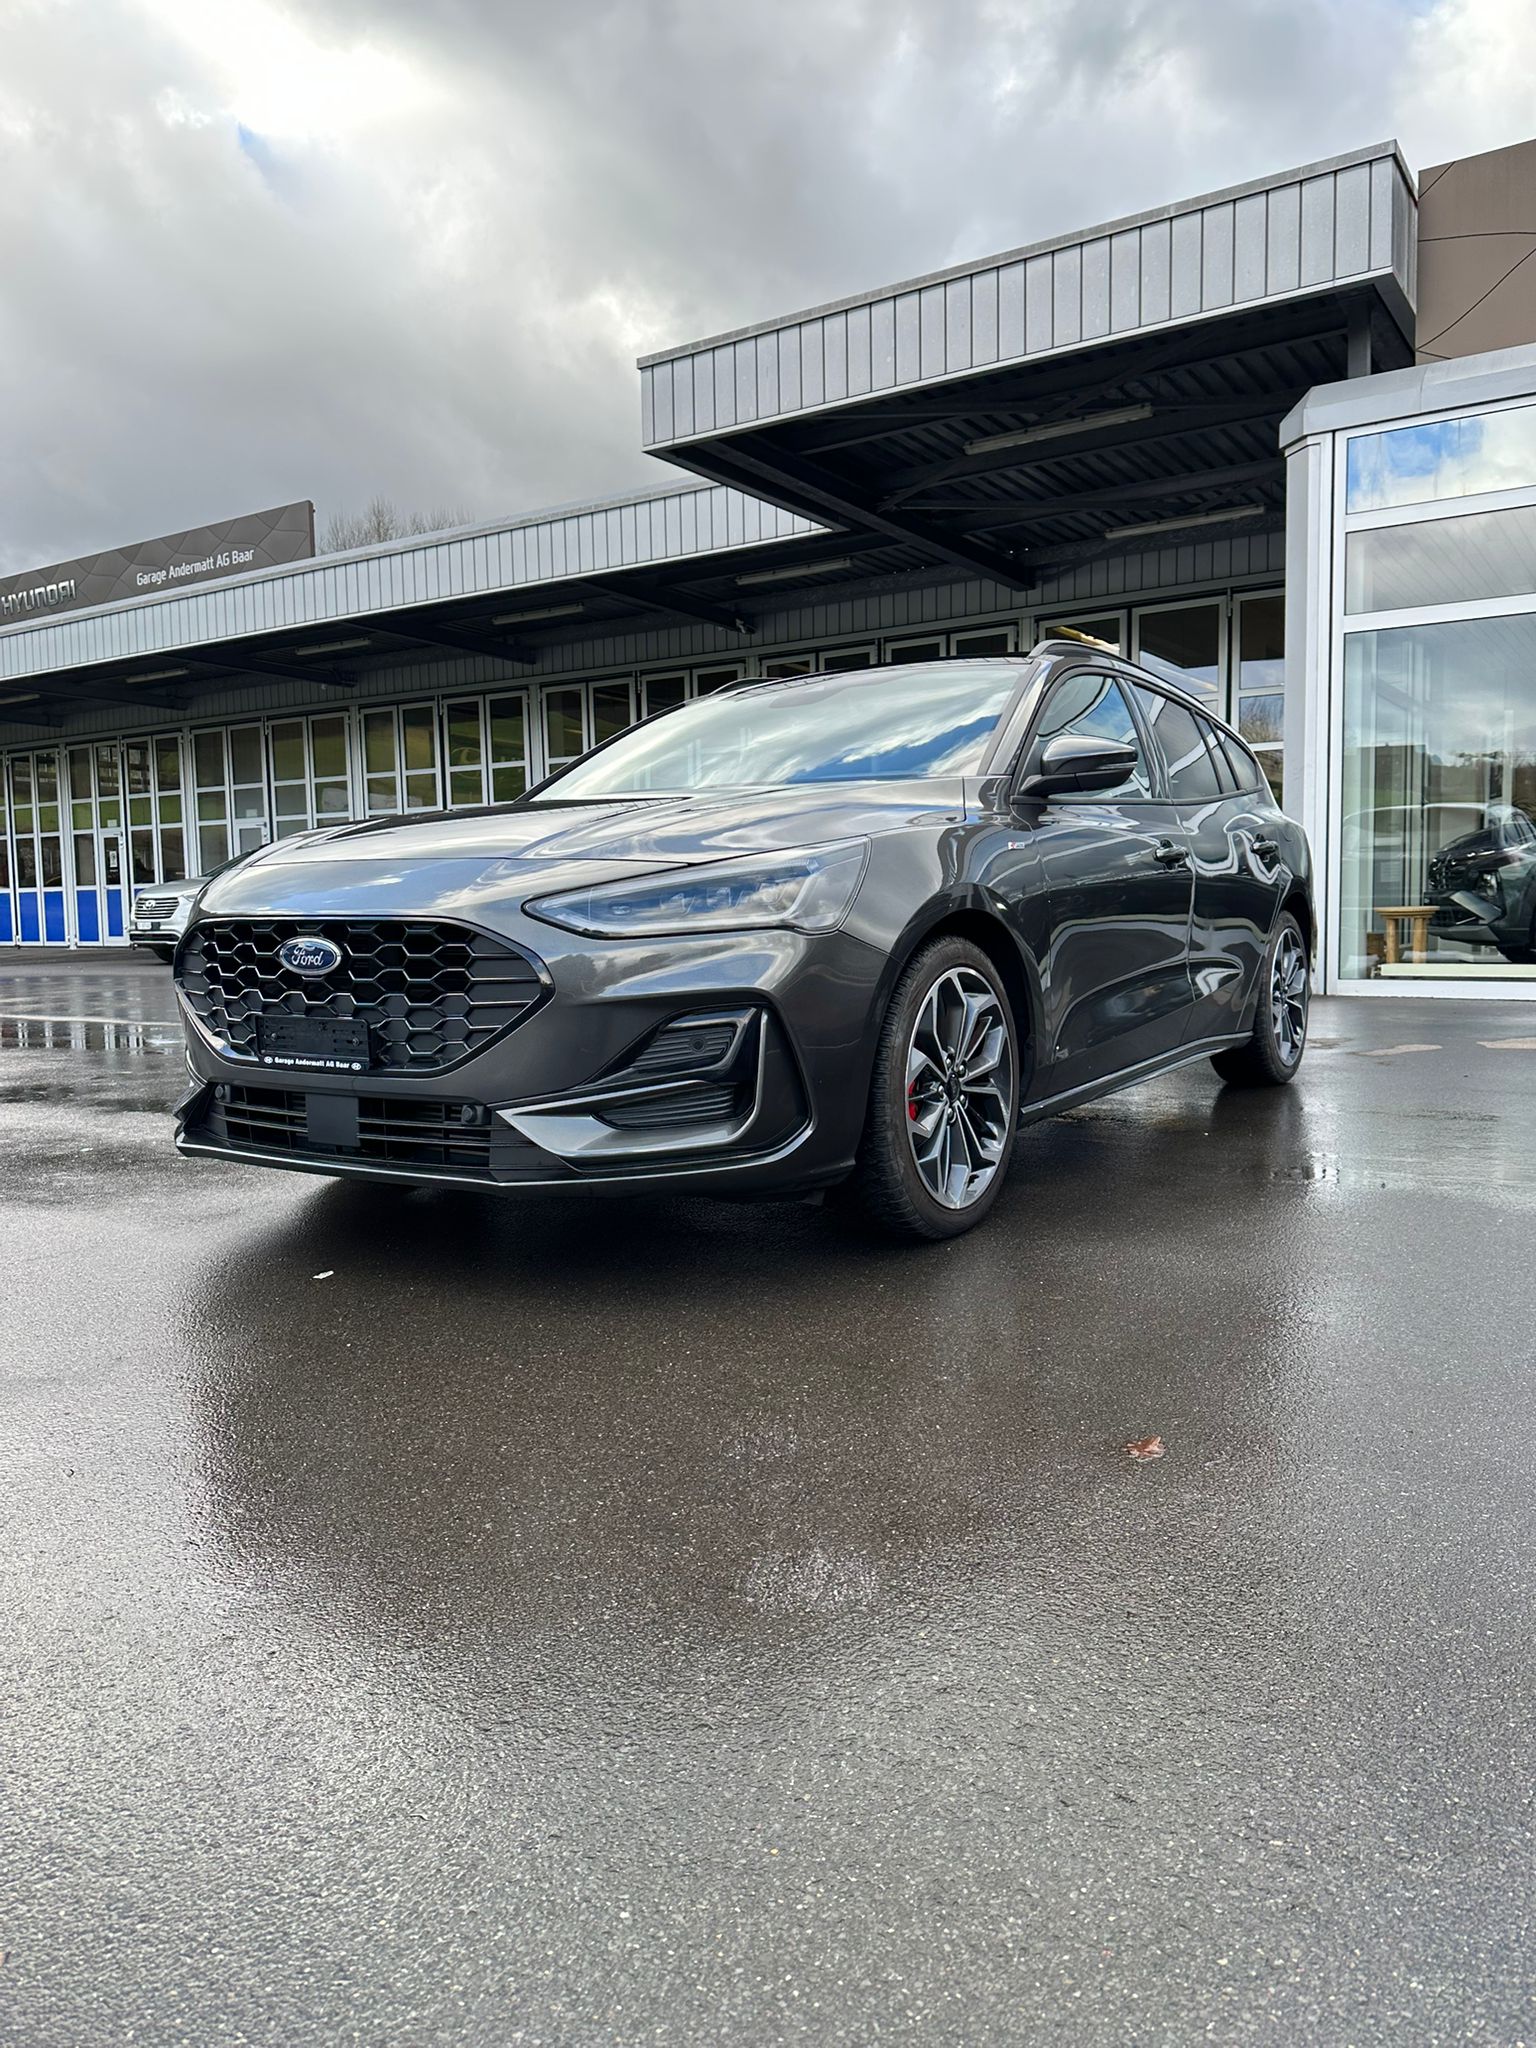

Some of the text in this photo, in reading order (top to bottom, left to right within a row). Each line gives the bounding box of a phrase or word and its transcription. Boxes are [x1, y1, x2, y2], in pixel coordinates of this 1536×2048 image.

[136, 549, 255, 585] Garage Andermatt AG Baar
[1, 579, 77, 616] HYUNDAI
[291, 943, 324, 966] Ford
[274, 1056, 350, 1069] Garage Andermatt AG Baar
